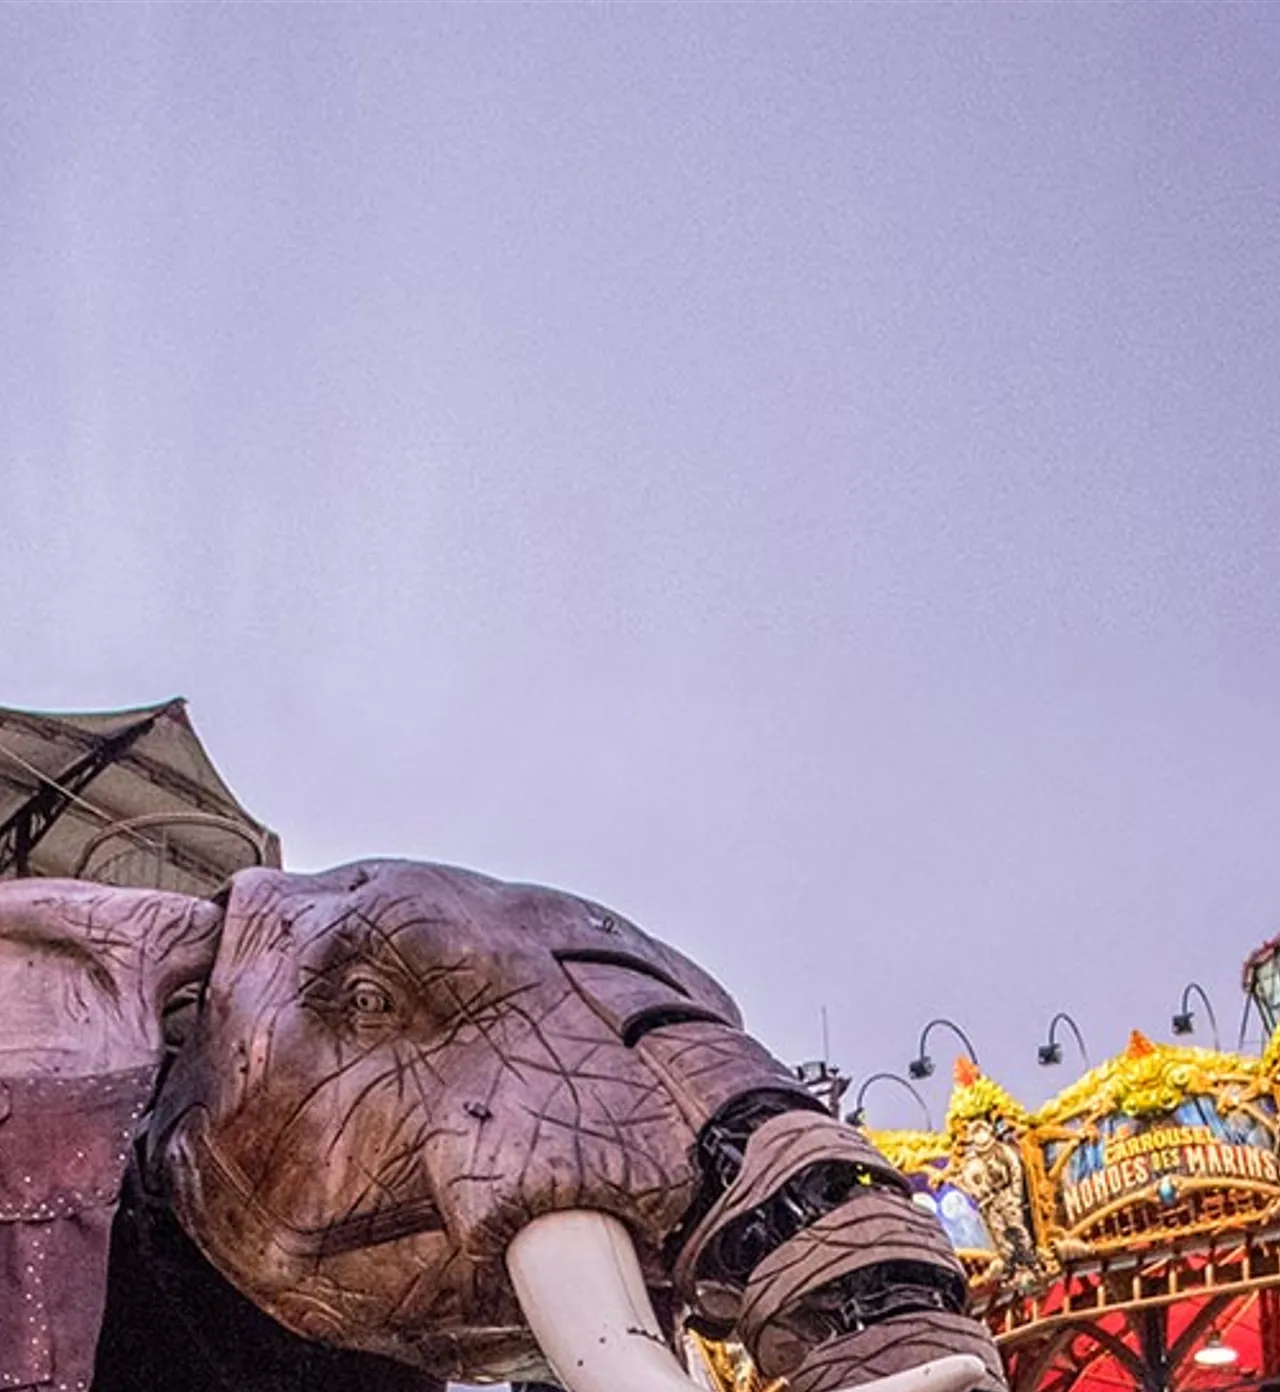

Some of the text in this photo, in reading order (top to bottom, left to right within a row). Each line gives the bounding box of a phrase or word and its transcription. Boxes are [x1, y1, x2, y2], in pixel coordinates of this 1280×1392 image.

[1104, 1126, 1217, 1165] CARROUSEL
[1063, 1145, 1278, 1226] MONDES DES MARINS
